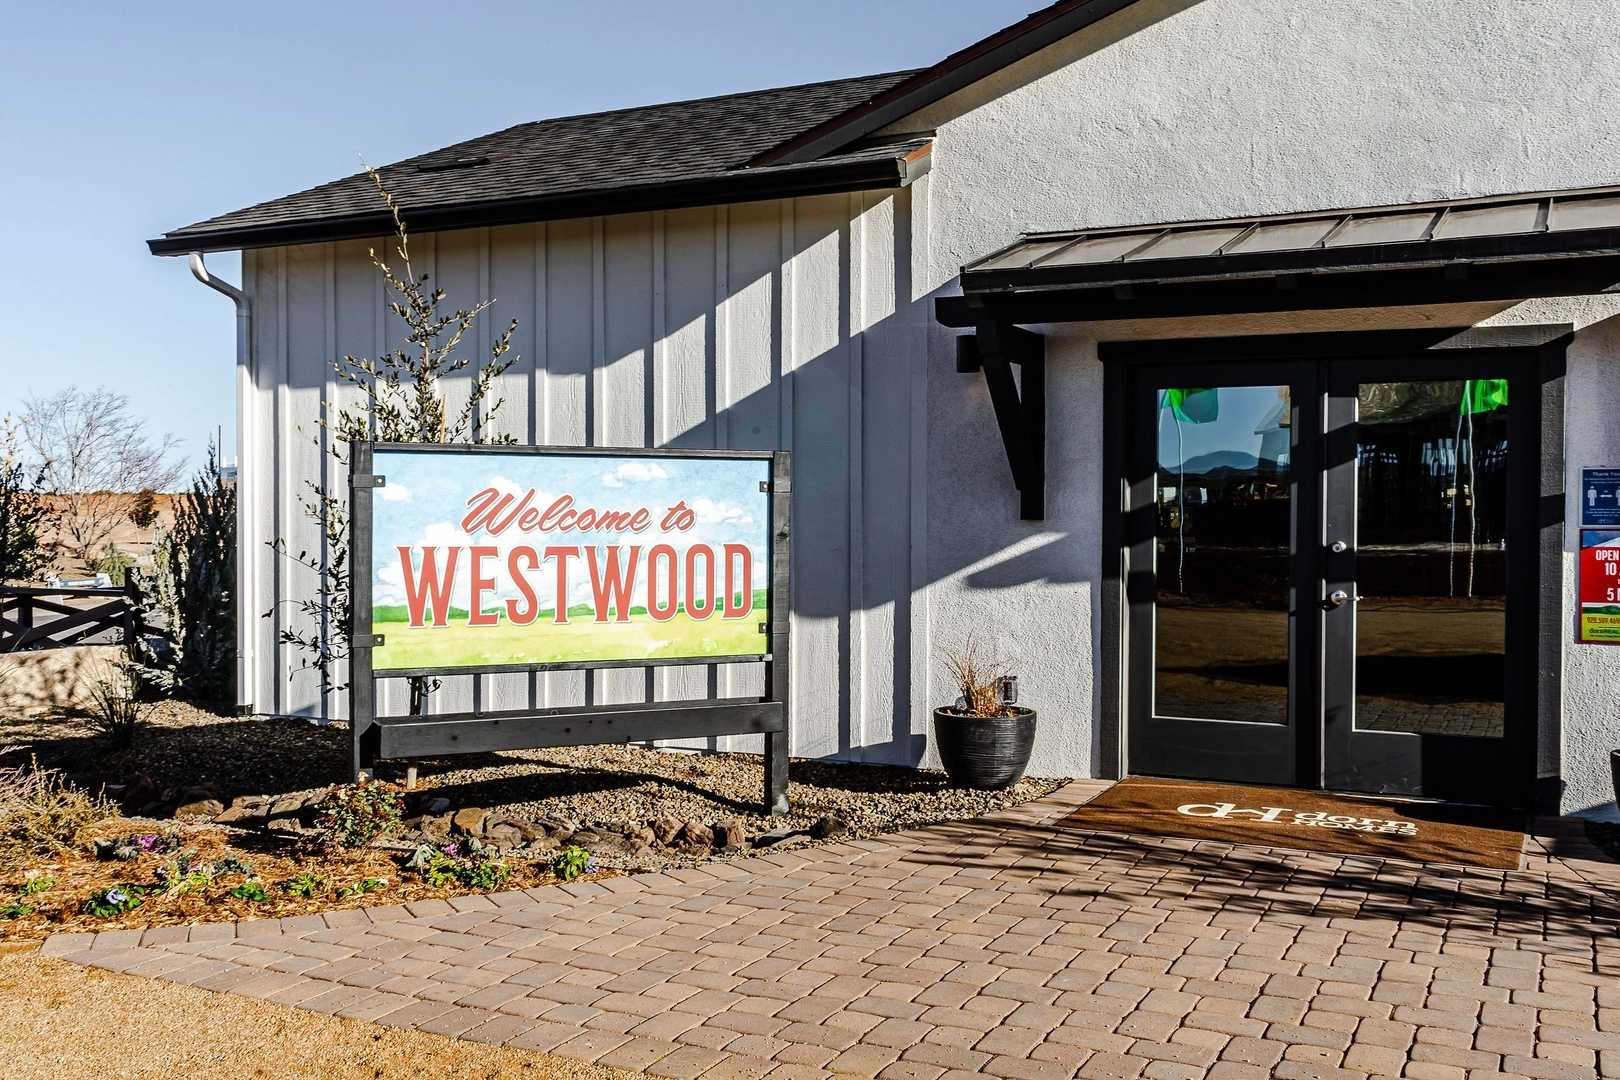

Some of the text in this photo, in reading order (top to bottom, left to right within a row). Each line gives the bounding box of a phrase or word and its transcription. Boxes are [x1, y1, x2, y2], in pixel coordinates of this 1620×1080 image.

[461, 487, 696, 536] Welcome to
[1595, 549, 1620, 561] OPEN
[1604, 562, 1617, 576] 10
[396, 543, 753, 628] WESTWOOD
[1606, 587, 1615, 602] 5
[1290, 818, 1417, 836] HOMES
[1294, 811, 1416, 828] dorn
